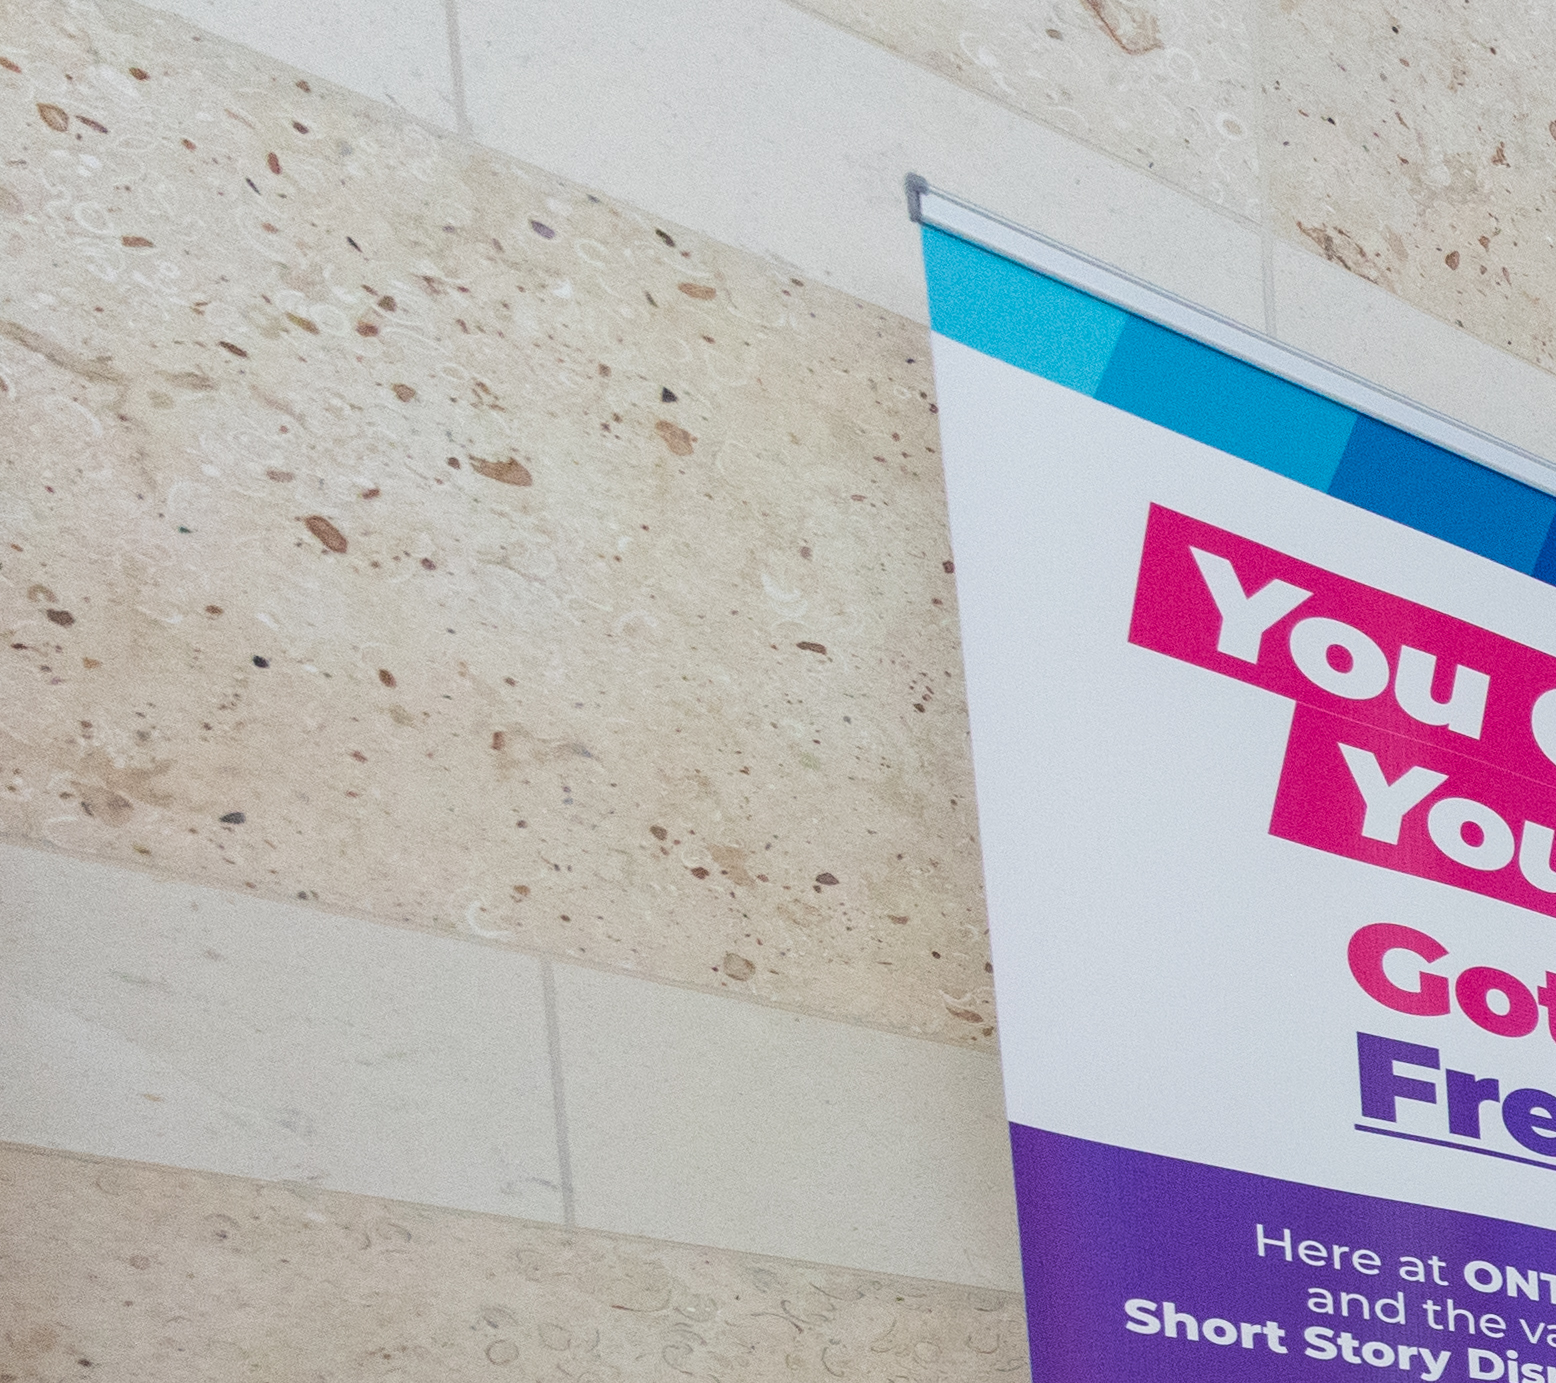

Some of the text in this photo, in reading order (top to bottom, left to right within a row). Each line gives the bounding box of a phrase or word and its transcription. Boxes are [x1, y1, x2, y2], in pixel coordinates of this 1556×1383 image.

[1188, 546, 1490, 738] You
[1256, 1224, 1381, 1275] Here
[1399, 1256, 1448, 1285] at
[1125, 1299, 1287, 1353] Short
[1304, 1326, 1451, 1381] Story
[1308, 1288, 1405, 1324] and
[1422, 1299, 1506, 1338] the
